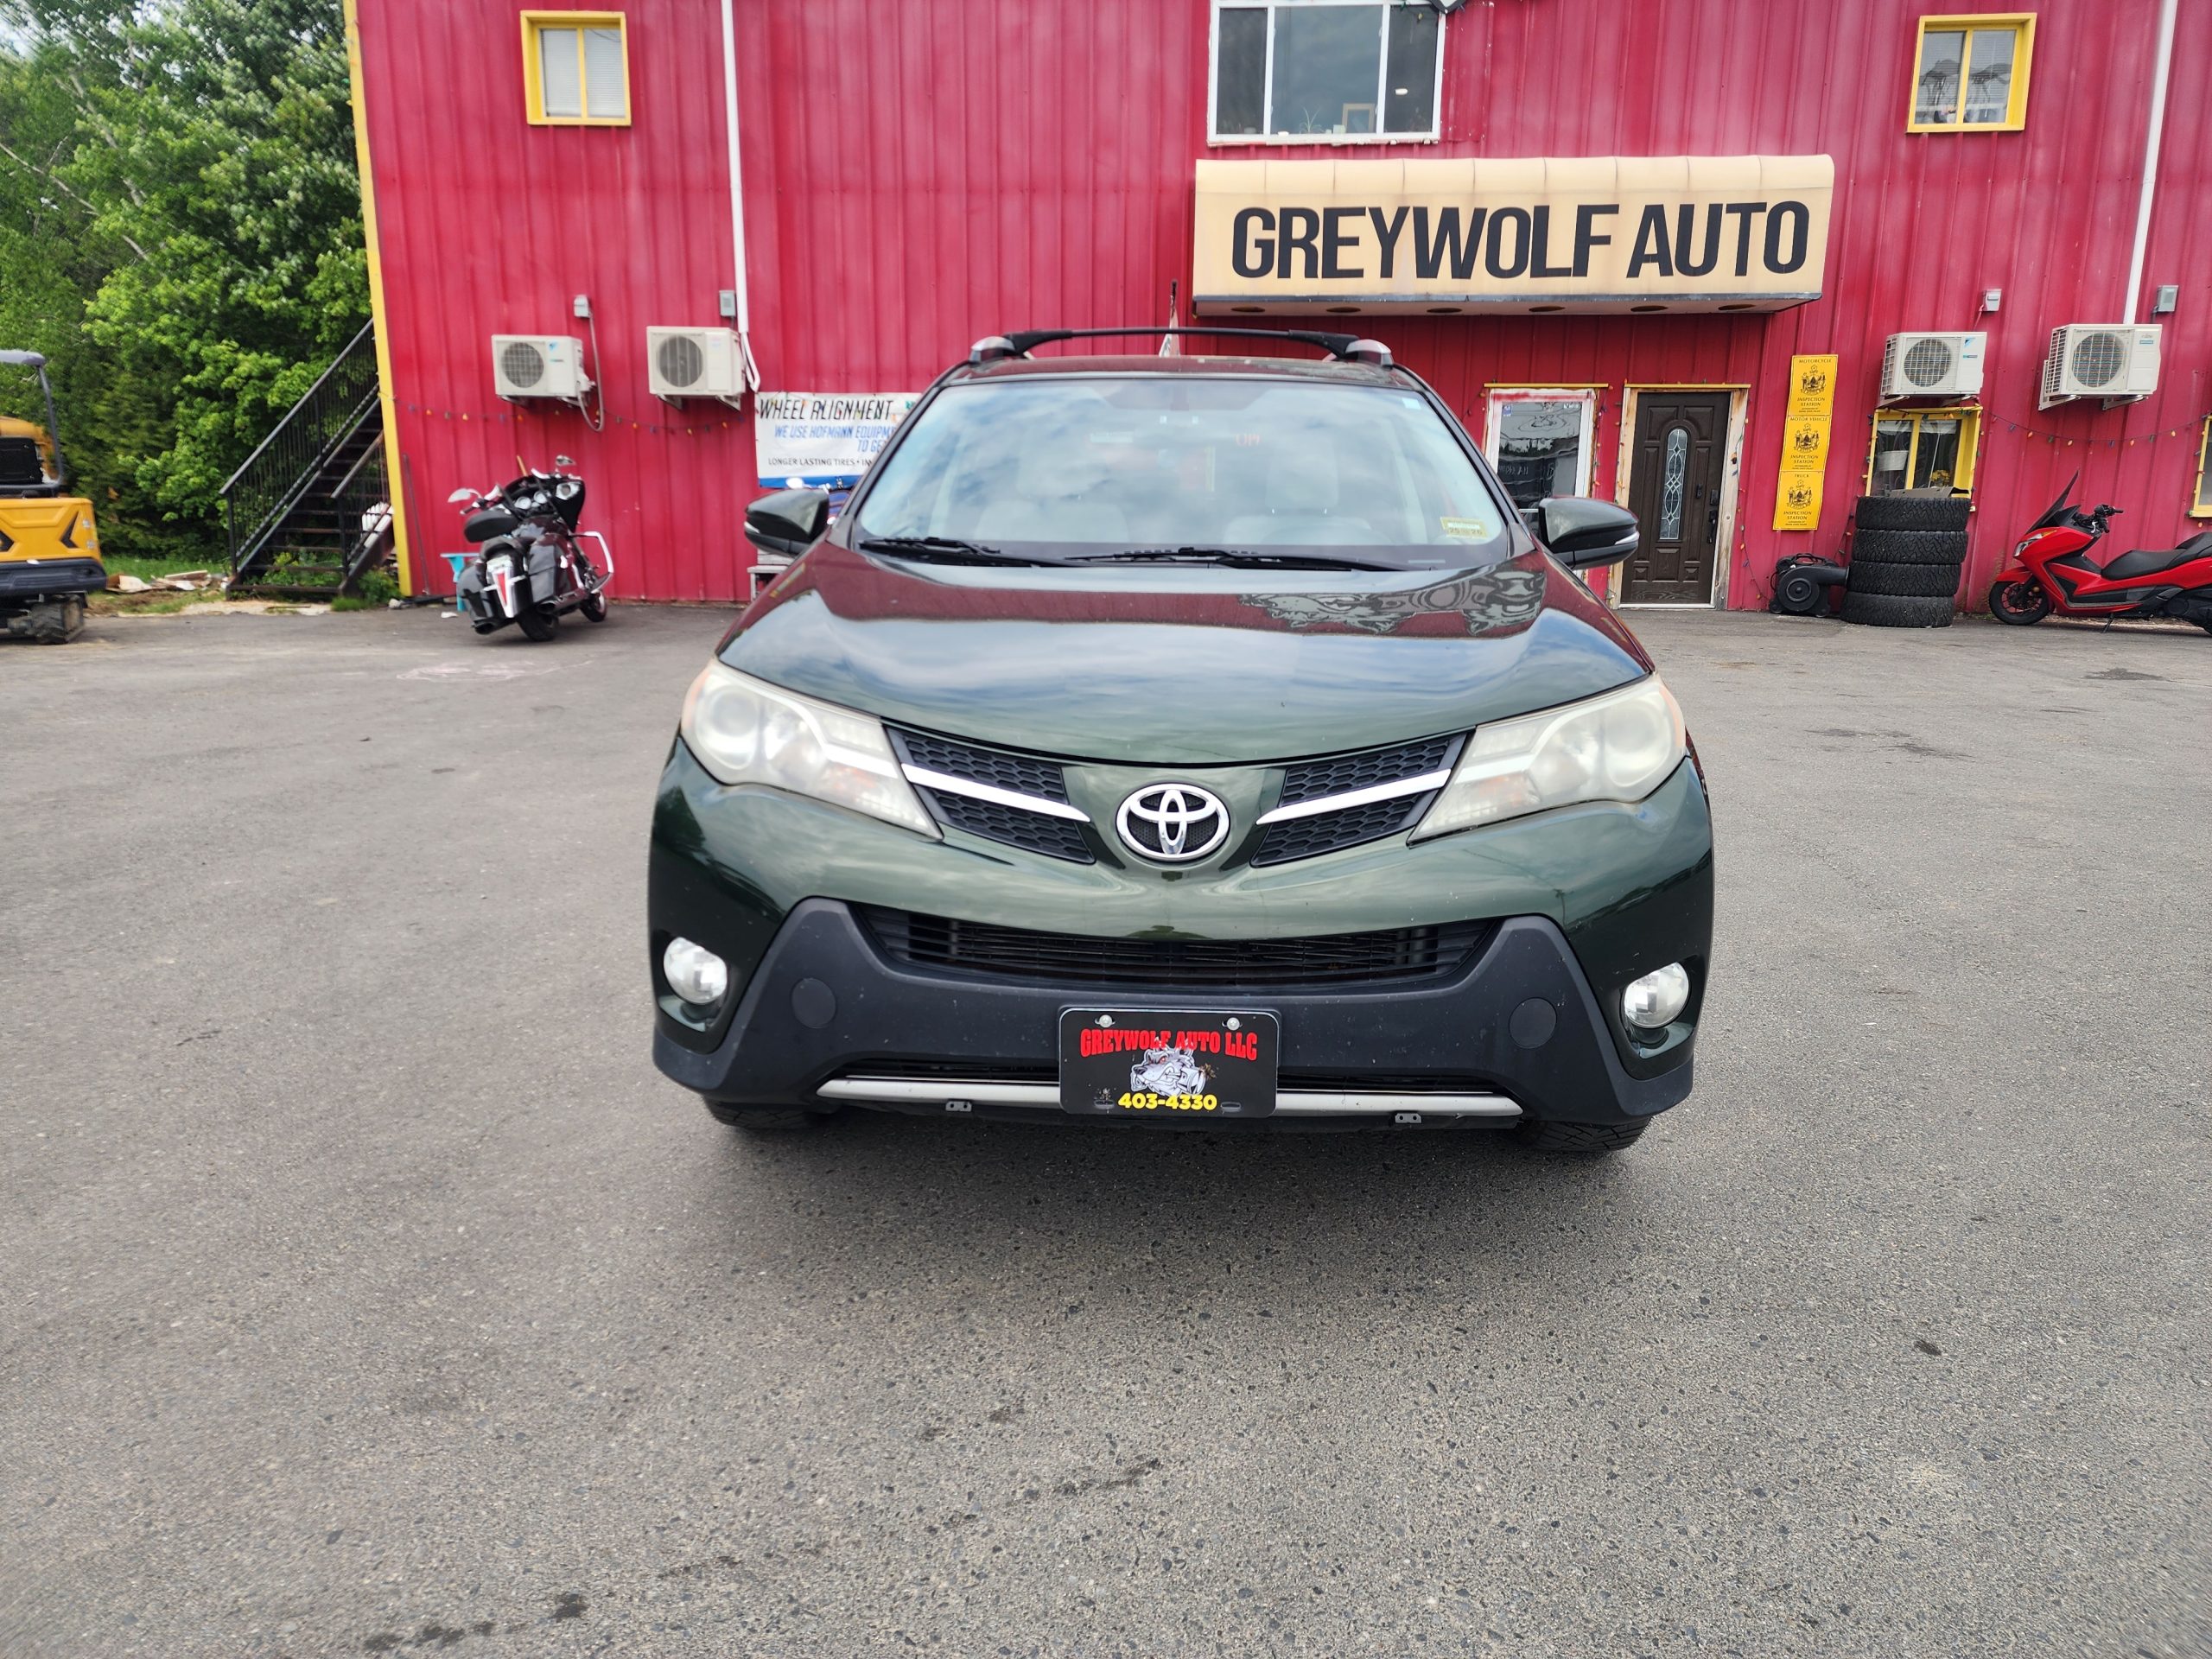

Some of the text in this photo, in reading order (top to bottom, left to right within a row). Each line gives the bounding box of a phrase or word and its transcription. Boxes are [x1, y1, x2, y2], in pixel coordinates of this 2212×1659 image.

[1231, 200, 1810, 280] GREYWOLF AUTO
[760, 398, 894, 421] WHEEL ALIGNMENT
[774, 424, 787, 439] WE
[790, 424, 810, 439] USE
[809, 424, 855, 439] HOFMANN
[857, 439, 870, 453] TO
[768, 457, 798, 467] LONGER
[799, 457, 832, 467] LASTING
[834, 457, 855, 467] TIRES
[1079, 1028, 1259, 1062] GREYWOLF AUTO LLC
[1117, 1092, 1218, 1111] 403-4330
